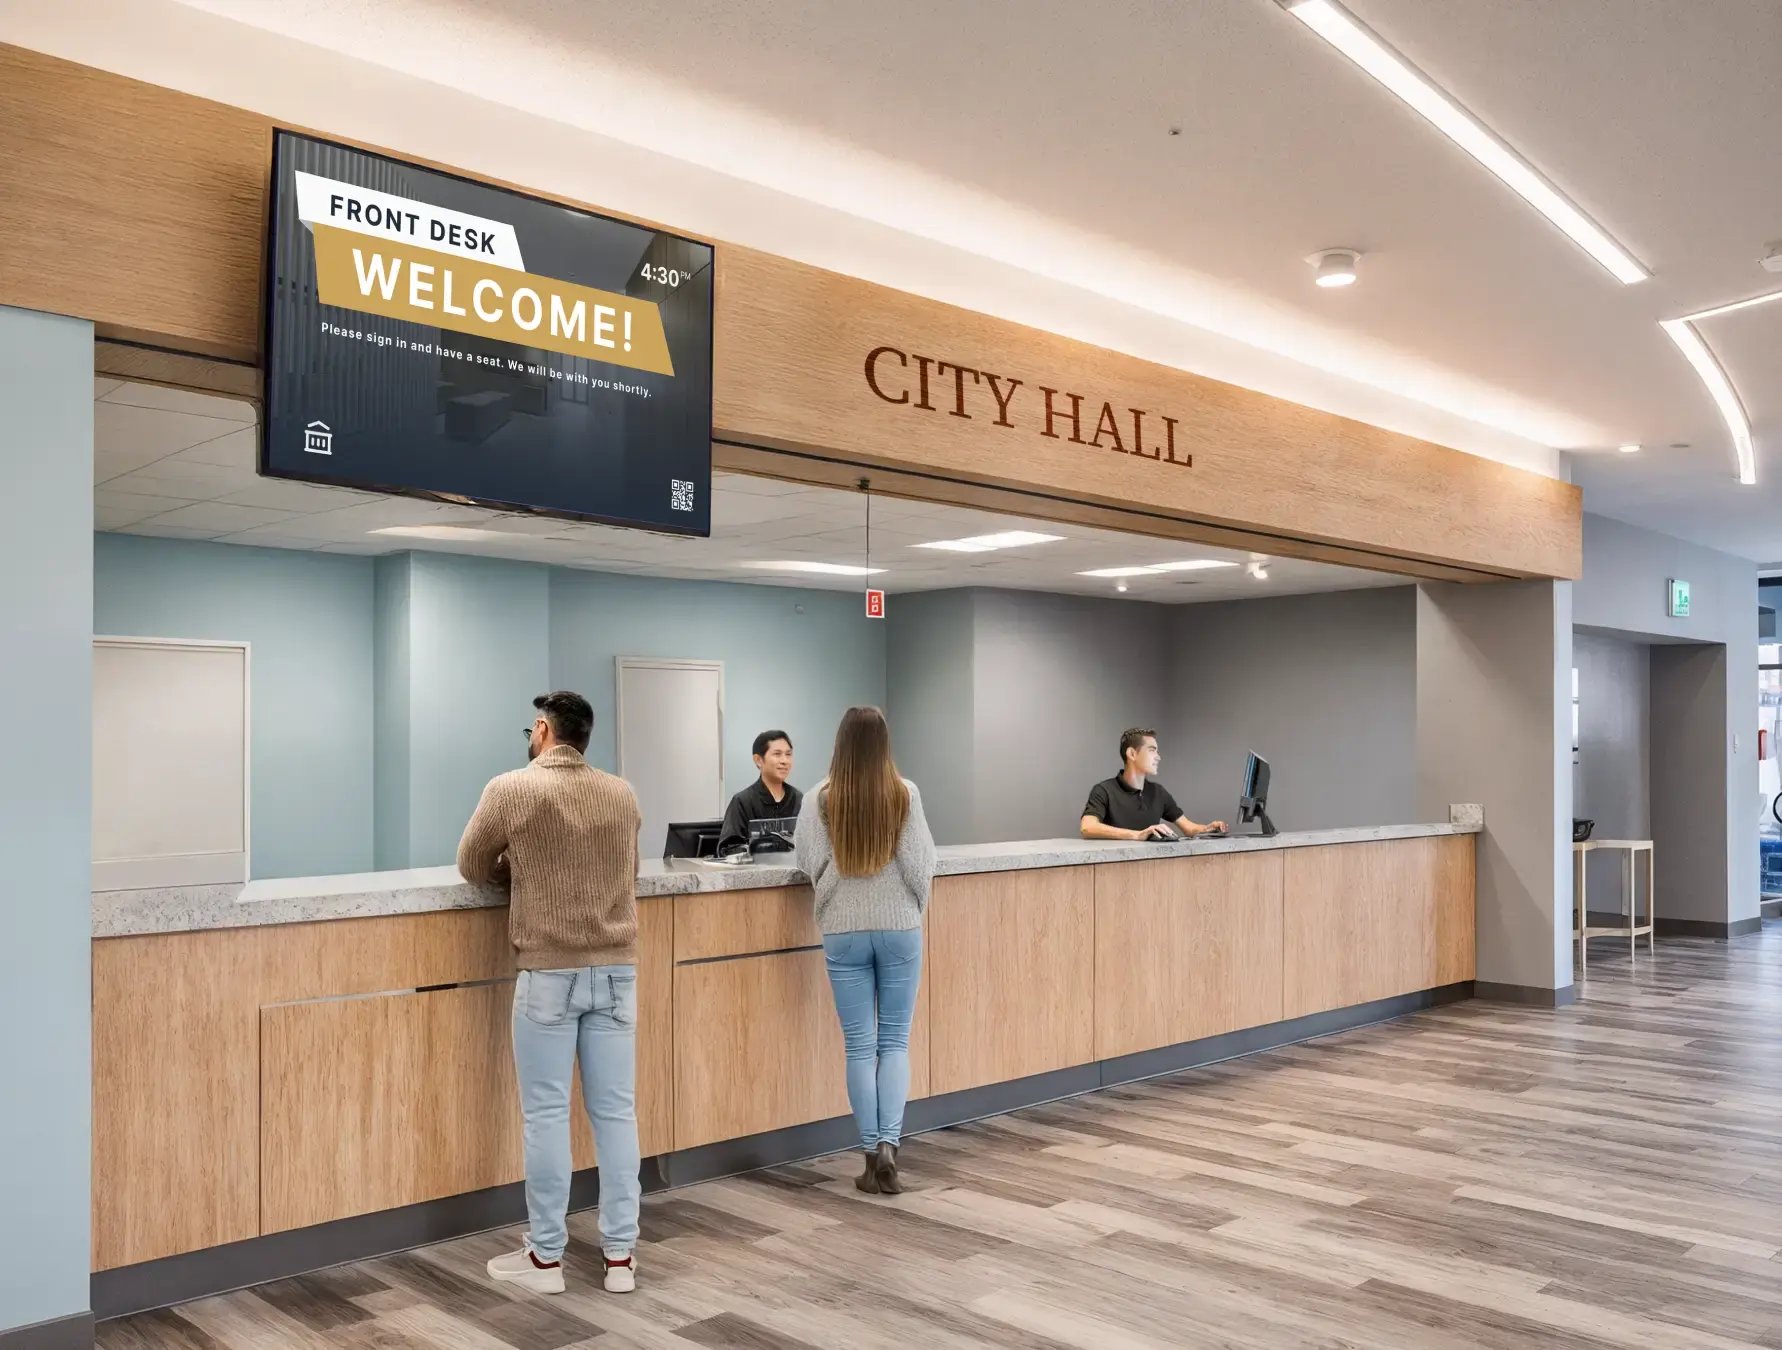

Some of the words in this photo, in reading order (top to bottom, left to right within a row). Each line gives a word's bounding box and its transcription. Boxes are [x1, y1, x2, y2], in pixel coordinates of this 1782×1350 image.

[330, 194, 420, 236] FRONT
[430, 220, 496, 255] DESK
[352, 248, 633, 352] WELCOME!
[640, 262, 680, 288] 4:30
[680, 270, 691, 281] PM
[321, 322, 362, 340] Please
[366, 332, 392, 346] sign
[396, 336, 407, 349] in
[410, 342, 432, 354] and
[436, 345, 463, 360] have
[466, 352, 473, 362] a
[476, 355, 504, 368] seat.
[507, 359, 524, 372] We
[527, 364, 547, 376] will
[549, 368, 563, 379] be
[565, 372, 589, 385] with
[591, 378, 610, 389] you
[612, 382, 652, 399] shortly.
[864, 346, 1024, 429] CITY
[1038, 385, 1194, 468] HALL
